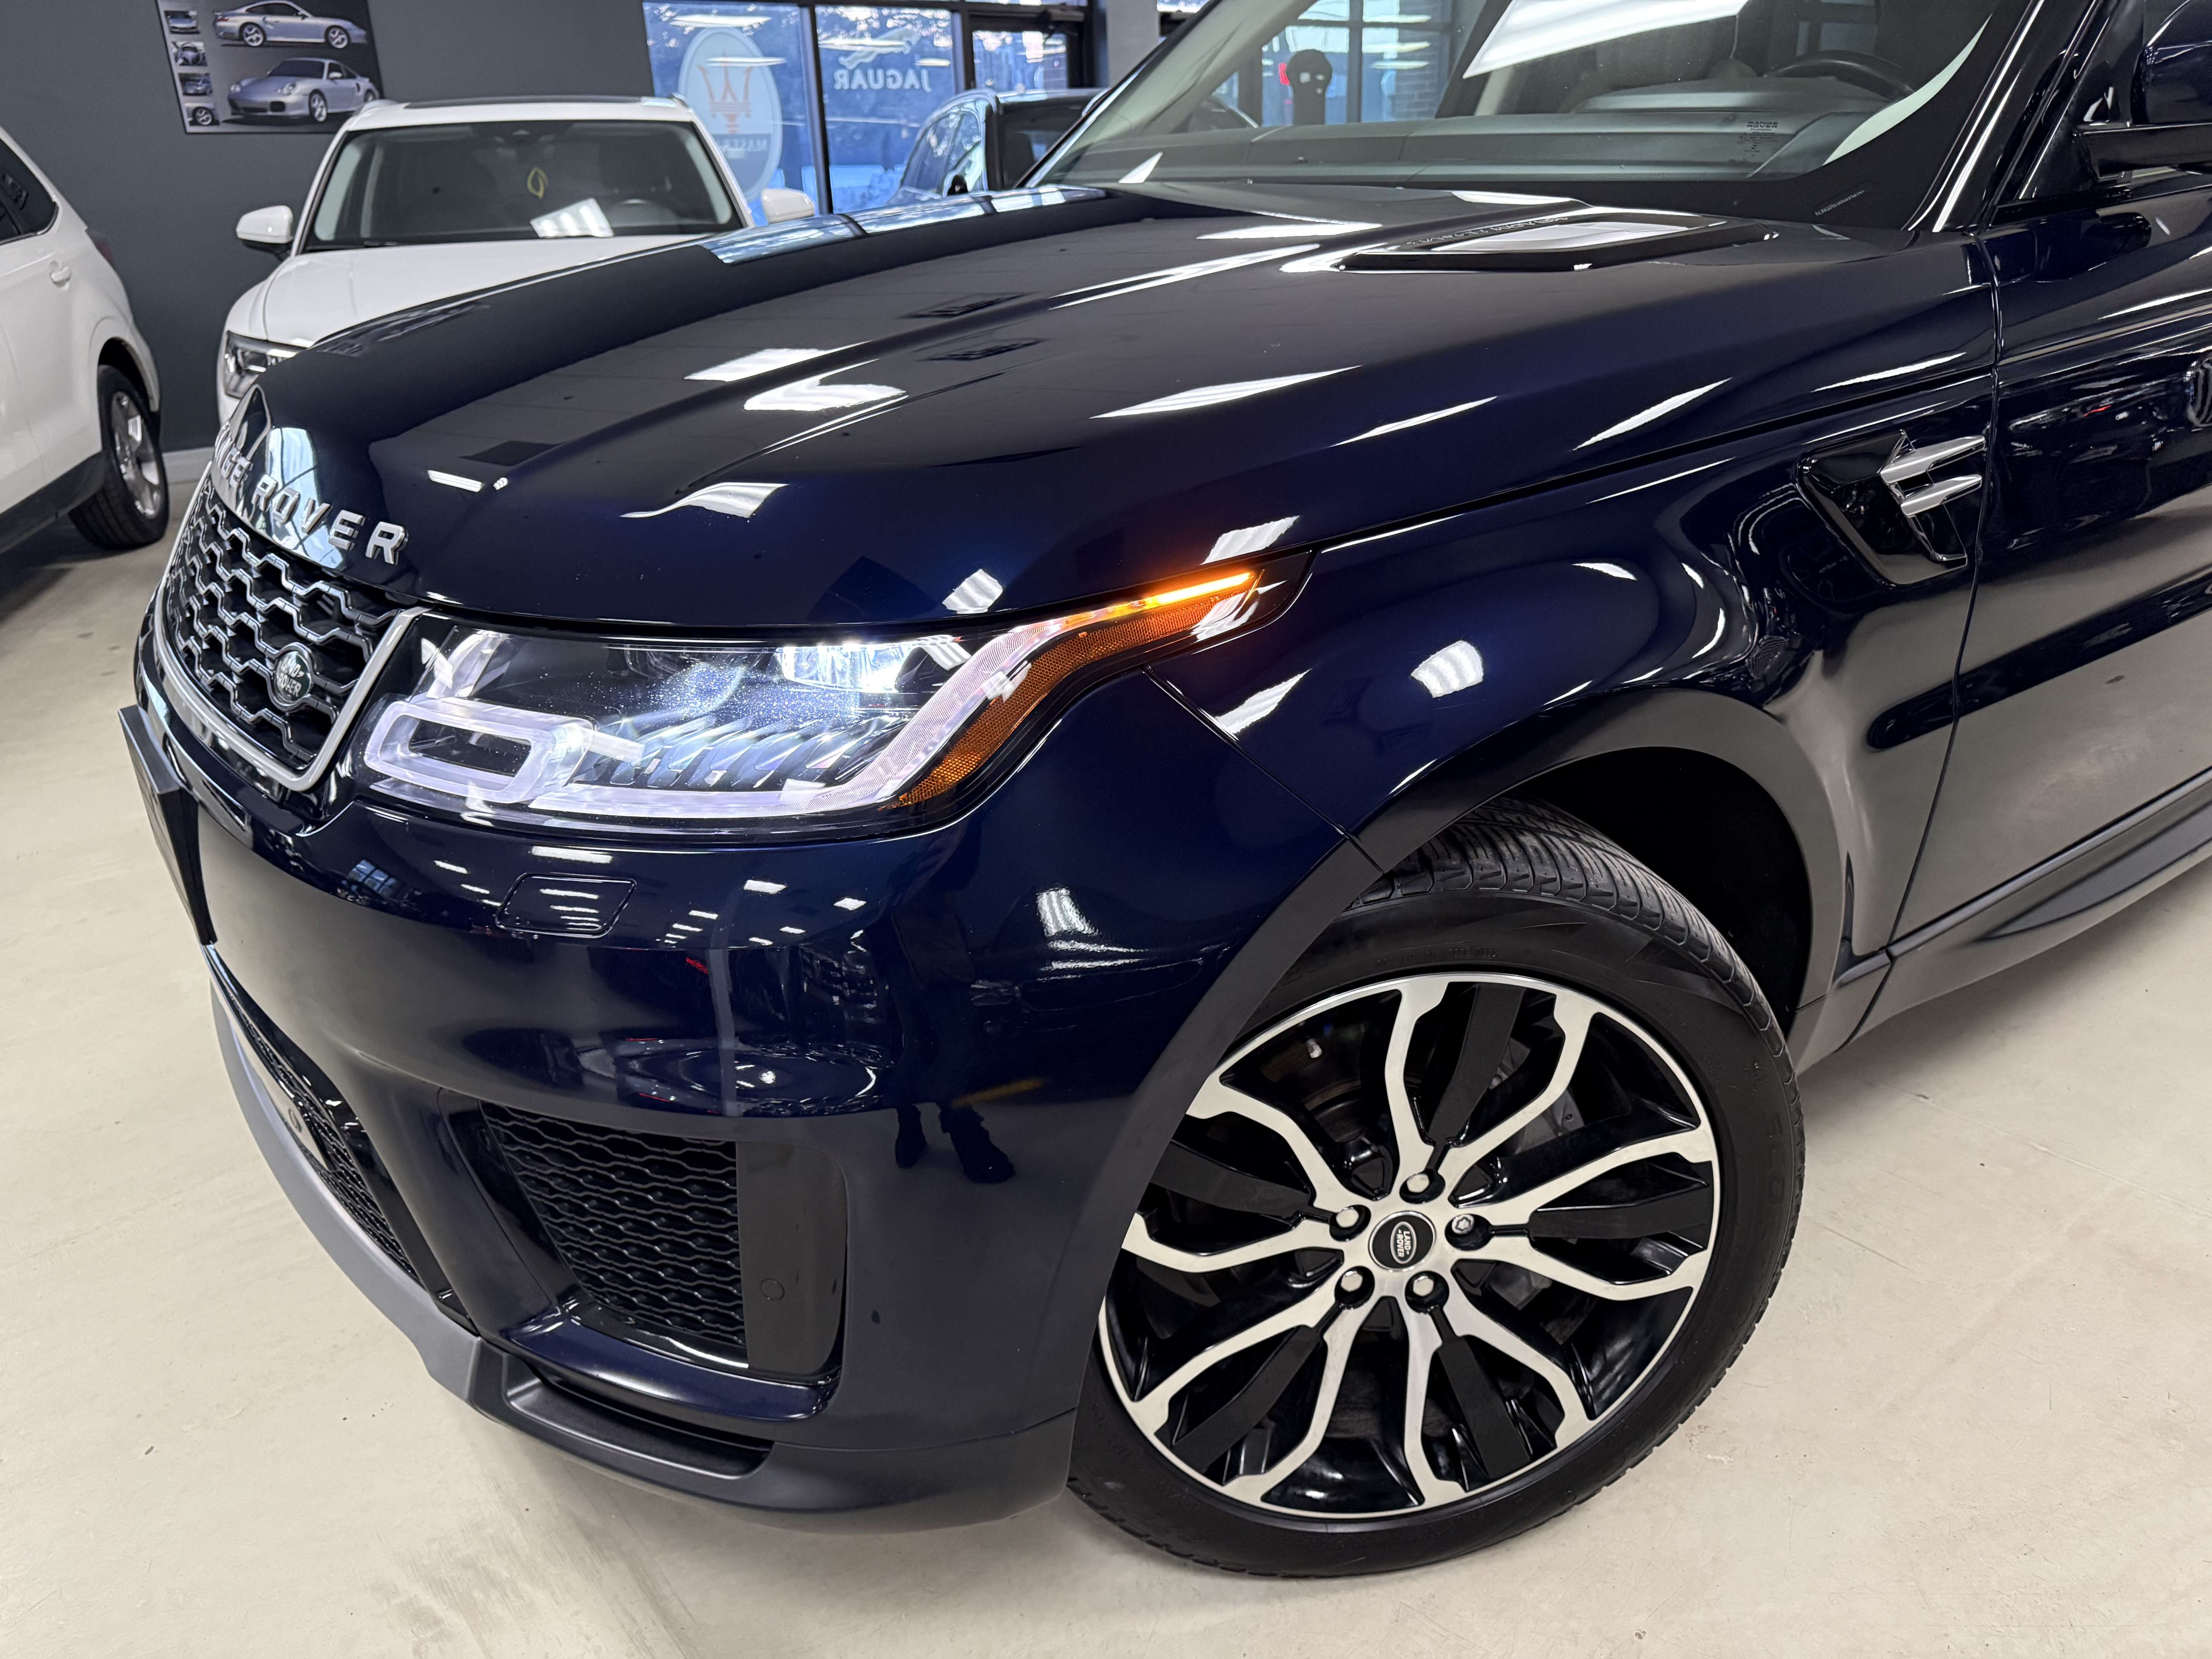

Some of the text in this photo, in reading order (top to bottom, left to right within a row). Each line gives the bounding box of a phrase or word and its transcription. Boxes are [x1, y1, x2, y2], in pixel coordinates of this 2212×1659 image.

[215, 421, 409, 565] NGE ROVER
[277, 672, 302, 697] ROVER
[1396, 1234, 1405, 1257] ROVER
